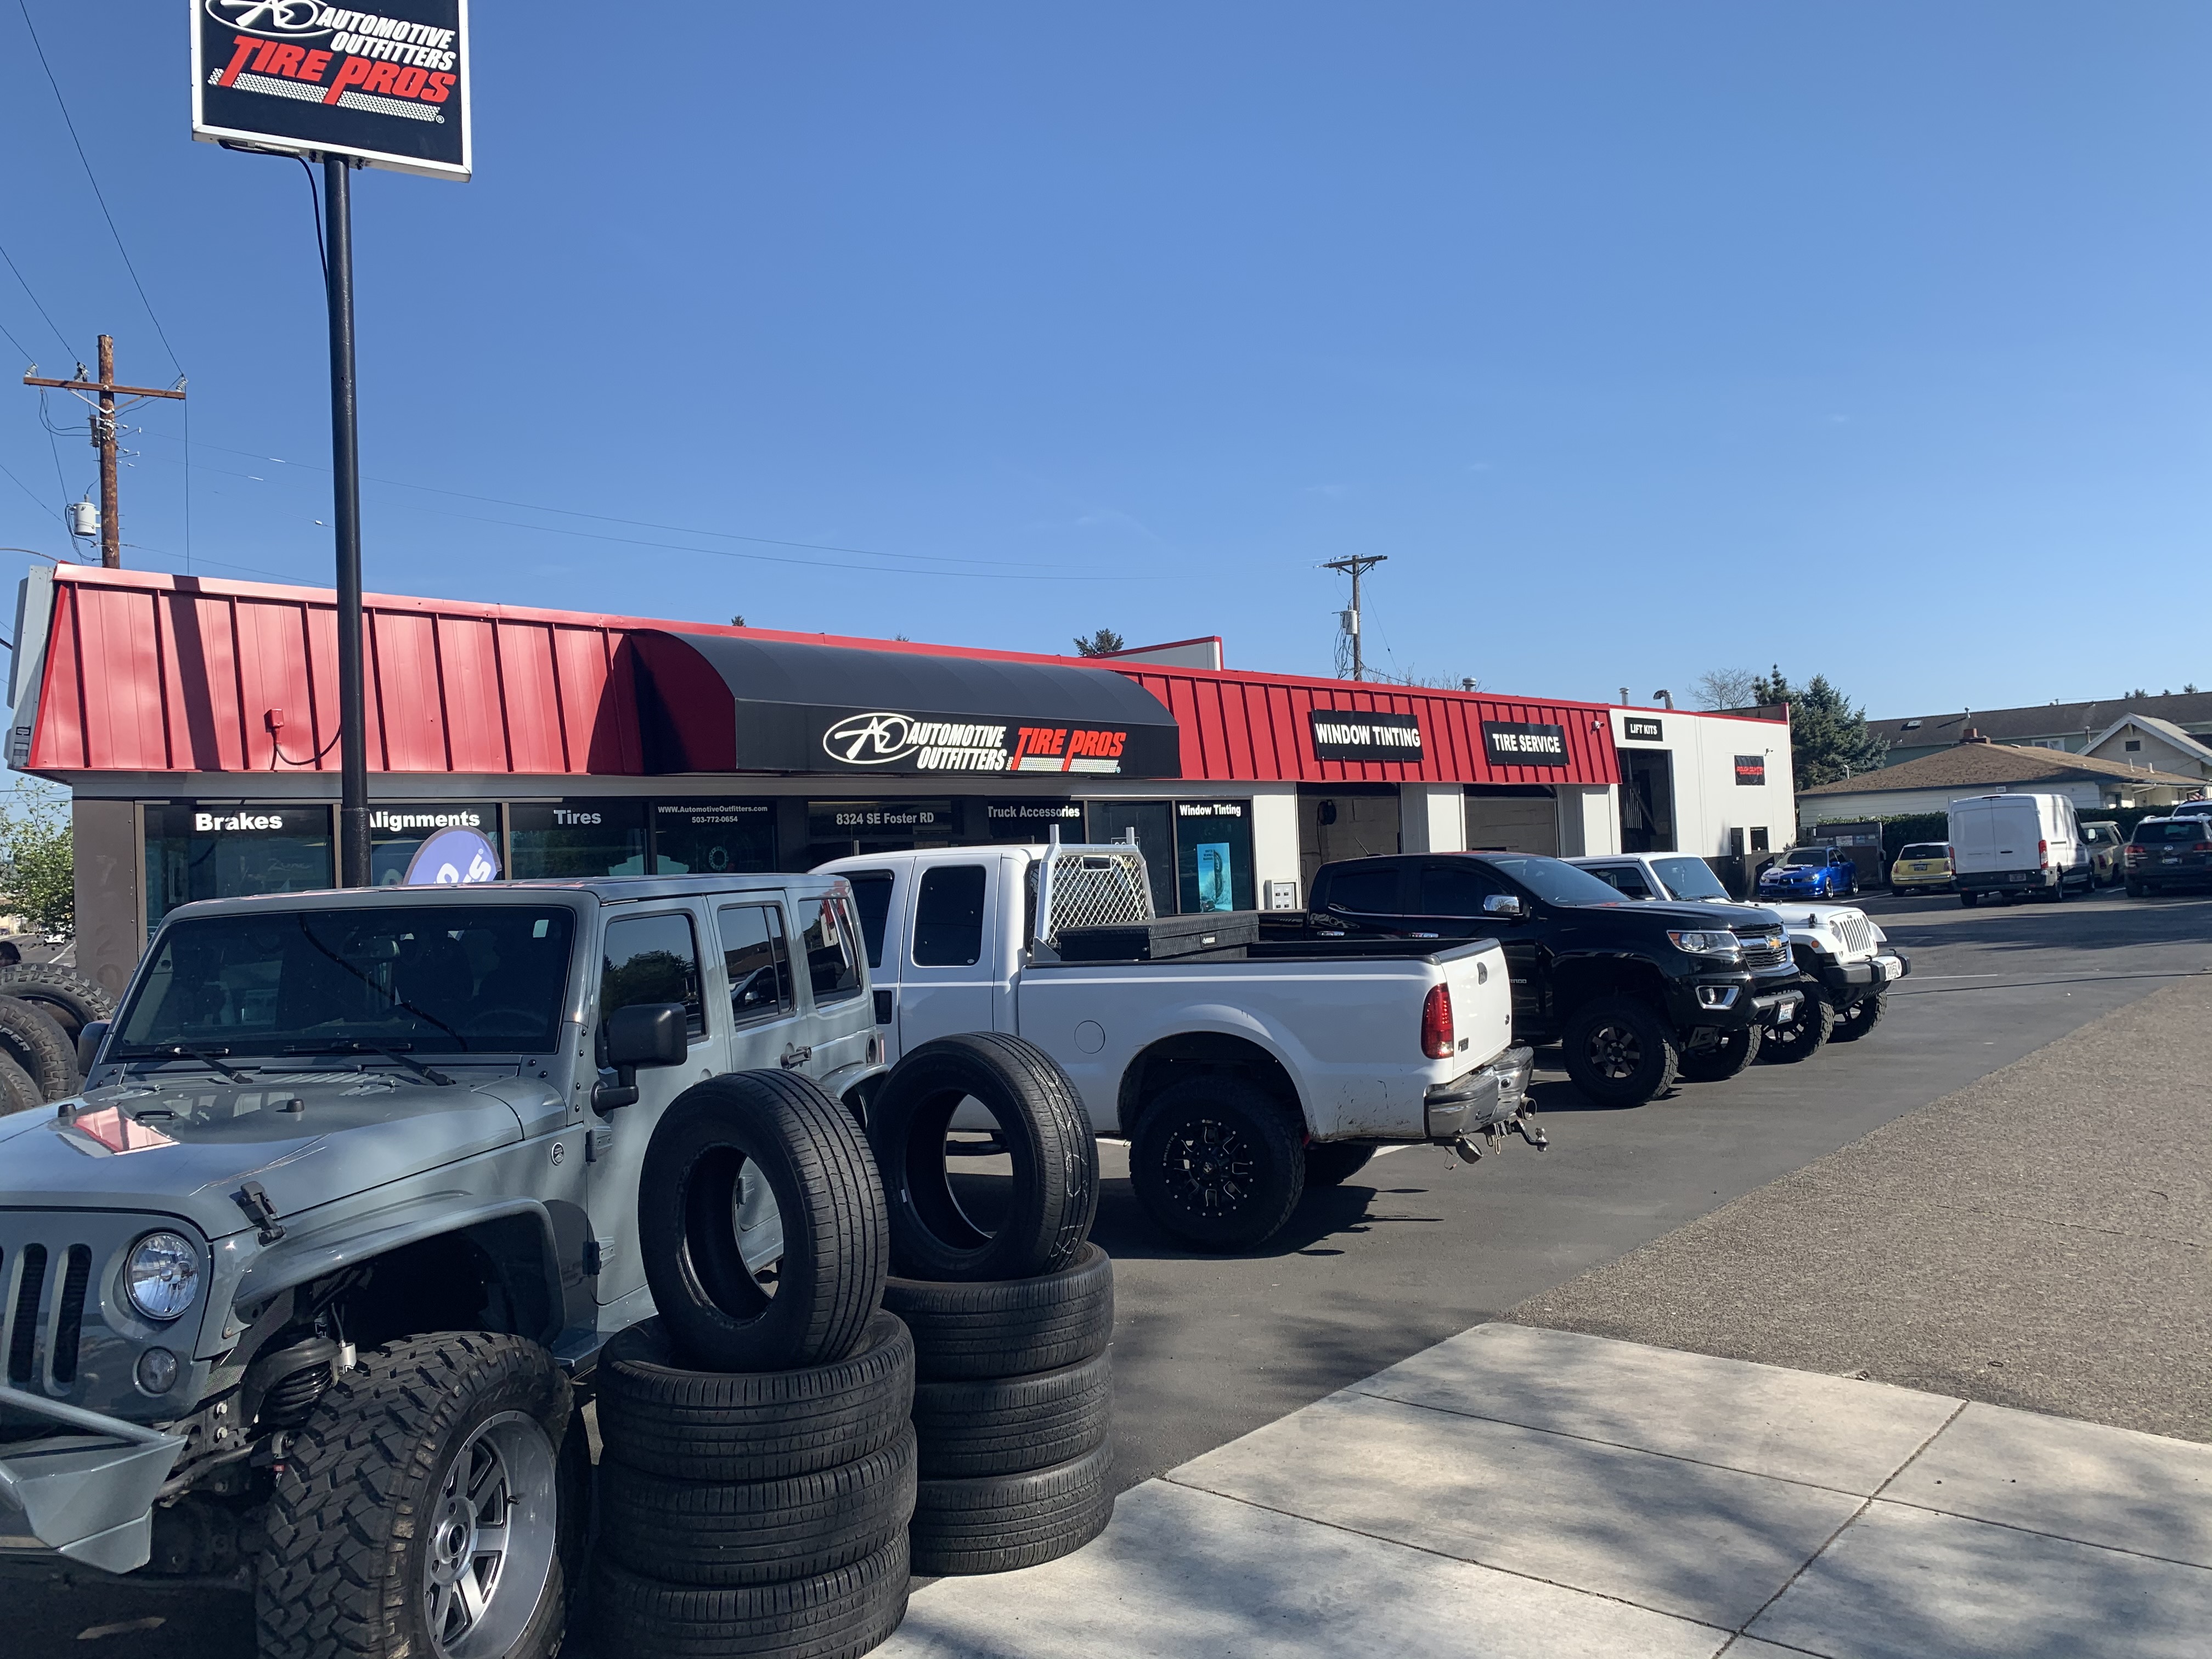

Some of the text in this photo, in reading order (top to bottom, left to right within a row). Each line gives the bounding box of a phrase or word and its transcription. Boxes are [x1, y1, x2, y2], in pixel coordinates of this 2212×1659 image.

[315, 6, 456, 50] AUTOMOTIVE
[330, 31, 456, 71] OUTFITTERS
[217, 35, 456, 105] TIRE PROS
[906, 722, 1007, 748] AUTOMOTIVE
[1314, 723, 1421, 749] WINDOW TINTING
[1630, 724, 1657, 735] LIFT KITS
[1011, 727, 1127, 772] TIRE PROS
[1492, 733, 1561, 754] TIRE SERVICE
[916, 748, 1007, 771] OUTFITTERS
[553, 809, 601, 825] Tires
[836, 812, 934, 825] 8324 SE Foster RD
[988, 806, 1080, 818] Truck Accessories
[1179, 804, 1242, 817] Window Tinting
[195, 813, 283, 831] Brakes
